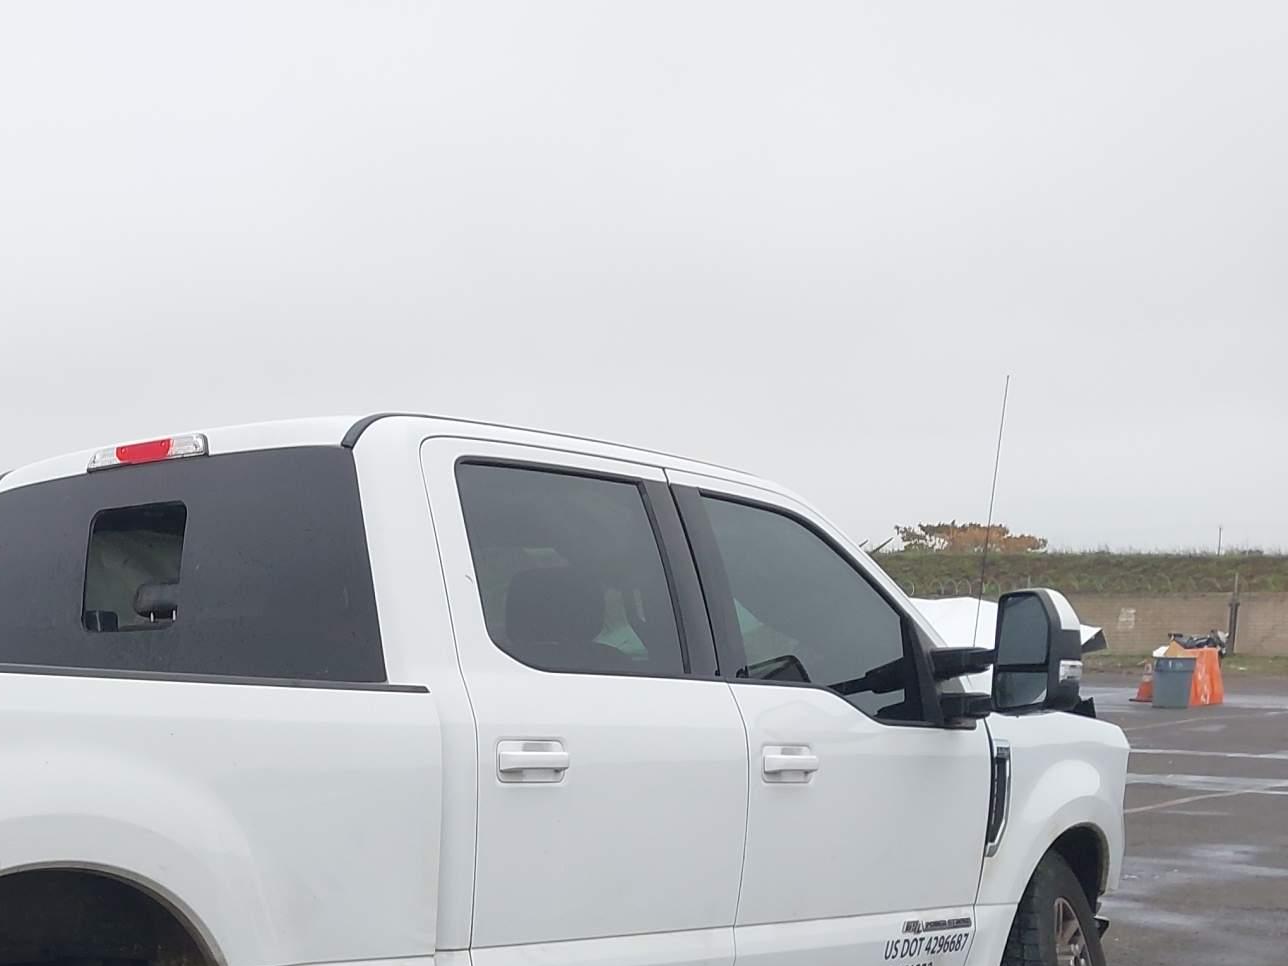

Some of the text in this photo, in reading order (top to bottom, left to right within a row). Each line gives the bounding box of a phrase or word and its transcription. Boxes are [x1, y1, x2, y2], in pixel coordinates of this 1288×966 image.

[884, 933, 969, 960] US DOT 4296687
